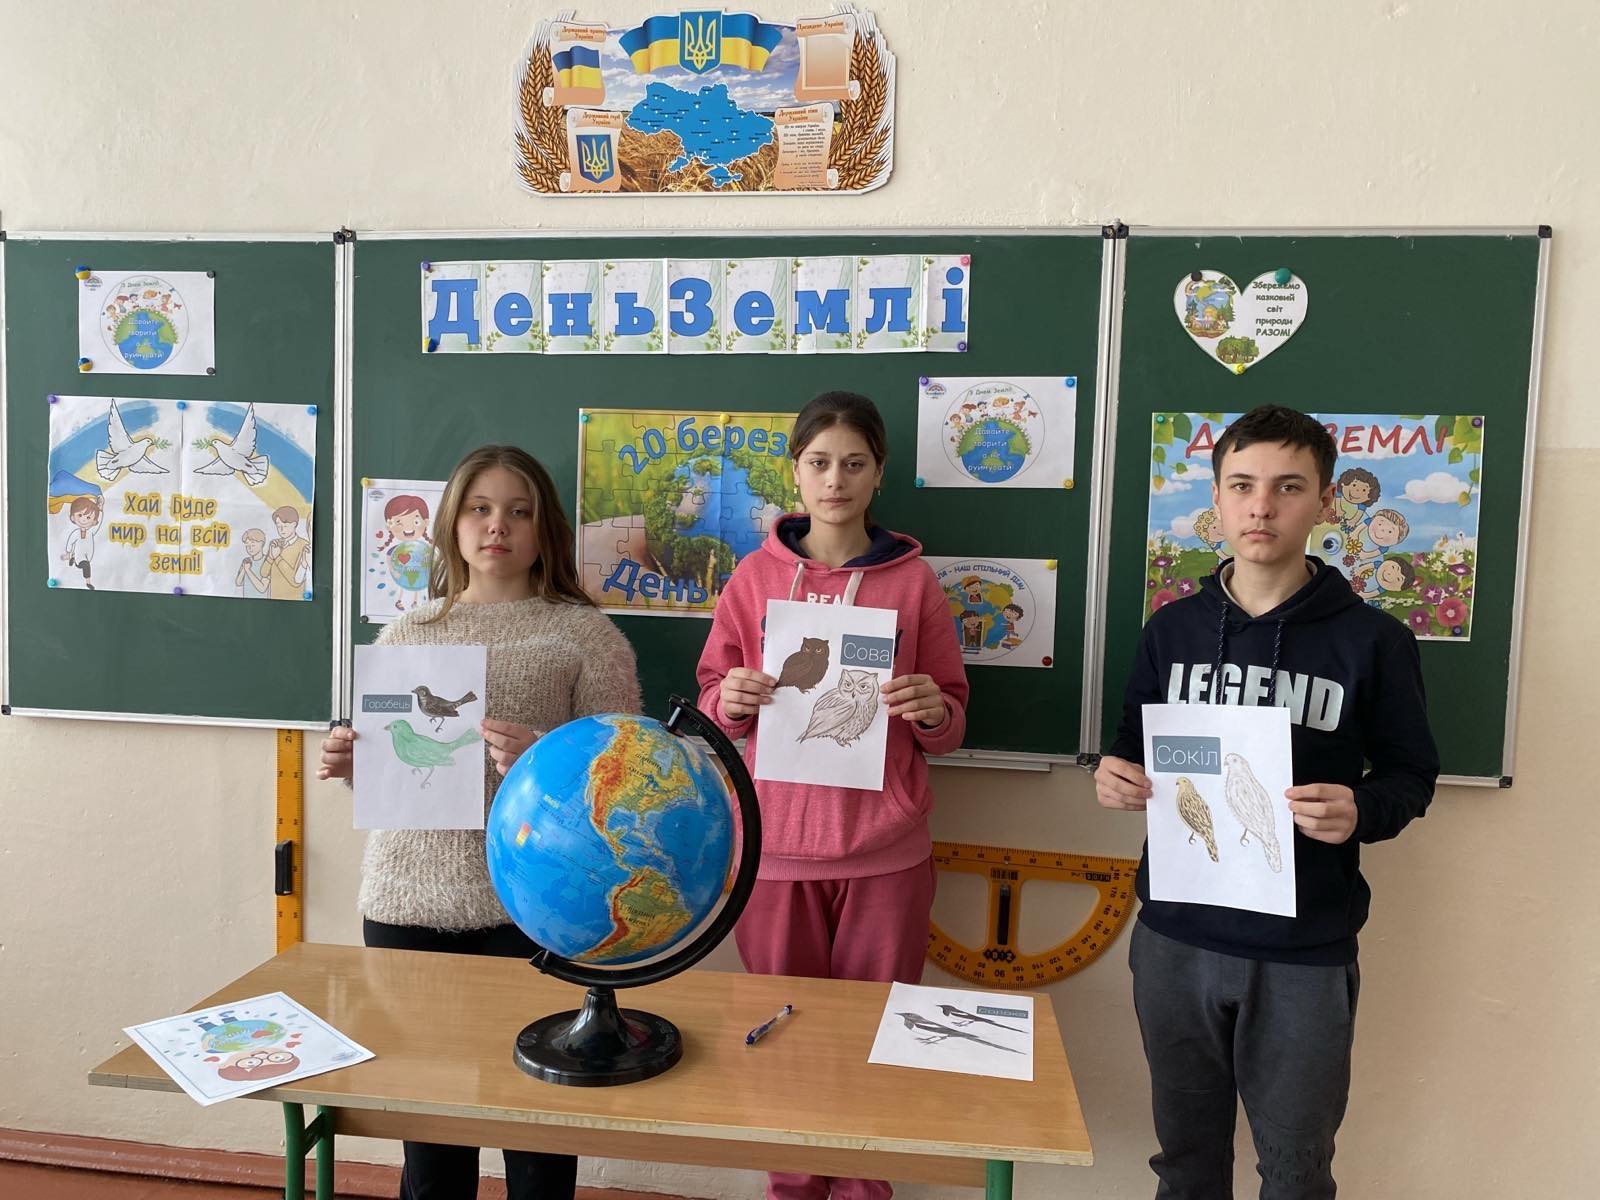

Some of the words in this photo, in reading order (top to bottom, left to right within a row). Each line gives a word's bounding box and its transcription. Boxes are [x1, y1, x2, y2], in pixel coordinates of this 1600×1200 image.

[1256, 293, 1295, 301] казковий
[1256, 318, 1293, 326] природи
[618, 428, 667, 475] 20
[677, 417, 793, 460] берез
[126, 495, 160, 513] Хай
[111, 526, 145, 545] мир
[157, 527, 180, 543] на
[192, 524, 228, 545] всій
[152, 552, 200, 572] землі!
[954, 565, 971, 573] НАШ
[602, 558, 709, 604] День
[843, 642, 890, 662] Сова
[363, 698, 411, 710] Горобець
[1167, 662, 1345, 732] LEGEND
[1156, 745, 1219, 766] Сокіл
[994, 969, 1006, 978] 90
